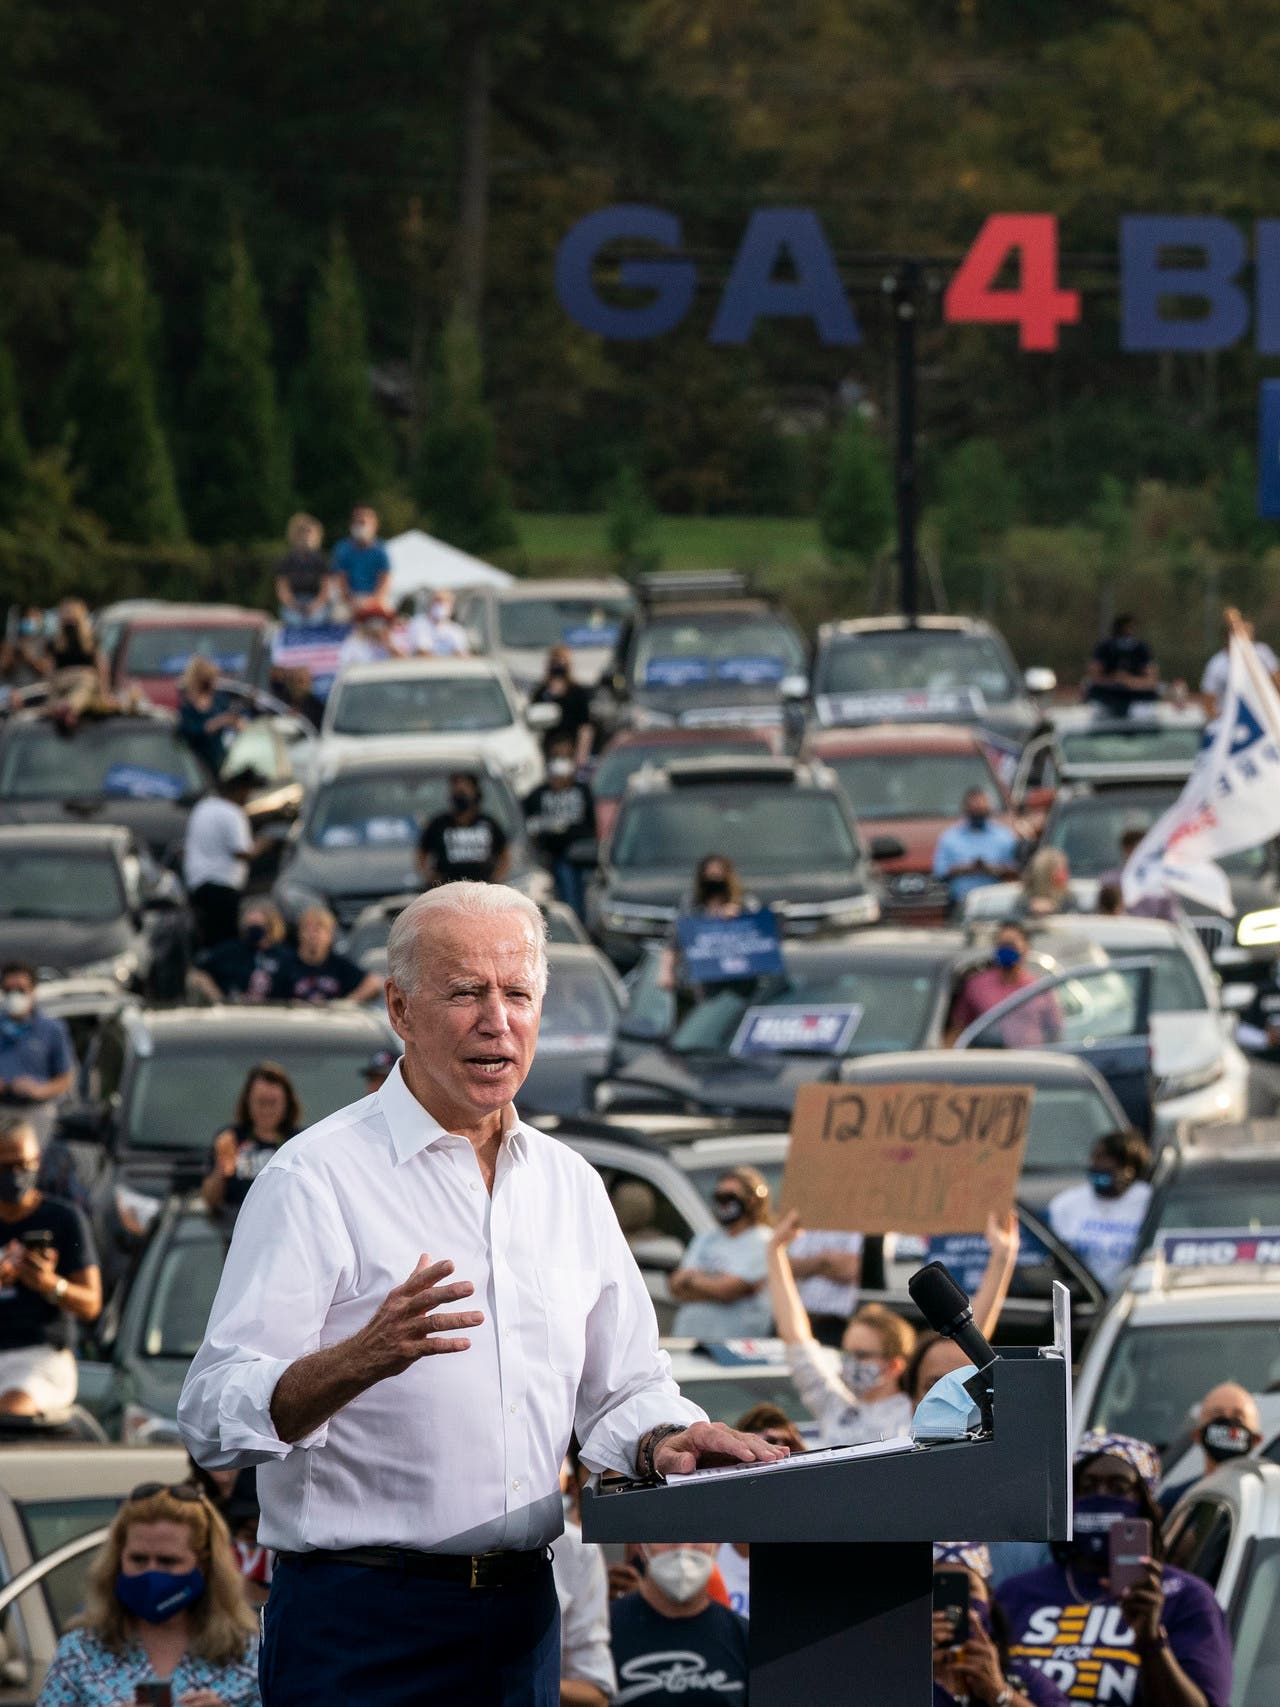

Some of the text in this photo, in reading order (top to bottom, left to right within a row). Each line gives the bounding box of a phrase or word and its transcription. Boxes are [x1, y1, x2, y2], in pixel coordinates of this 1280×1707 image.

[554, 203, 864, 347] GA
[943, 212, 1082, 352] 4
[1021, 1603, 1137, 1646] SEIU
[1053, 1645, 1094, 1661] FOR
[1030, 1658, 1139, 1701] DEN
